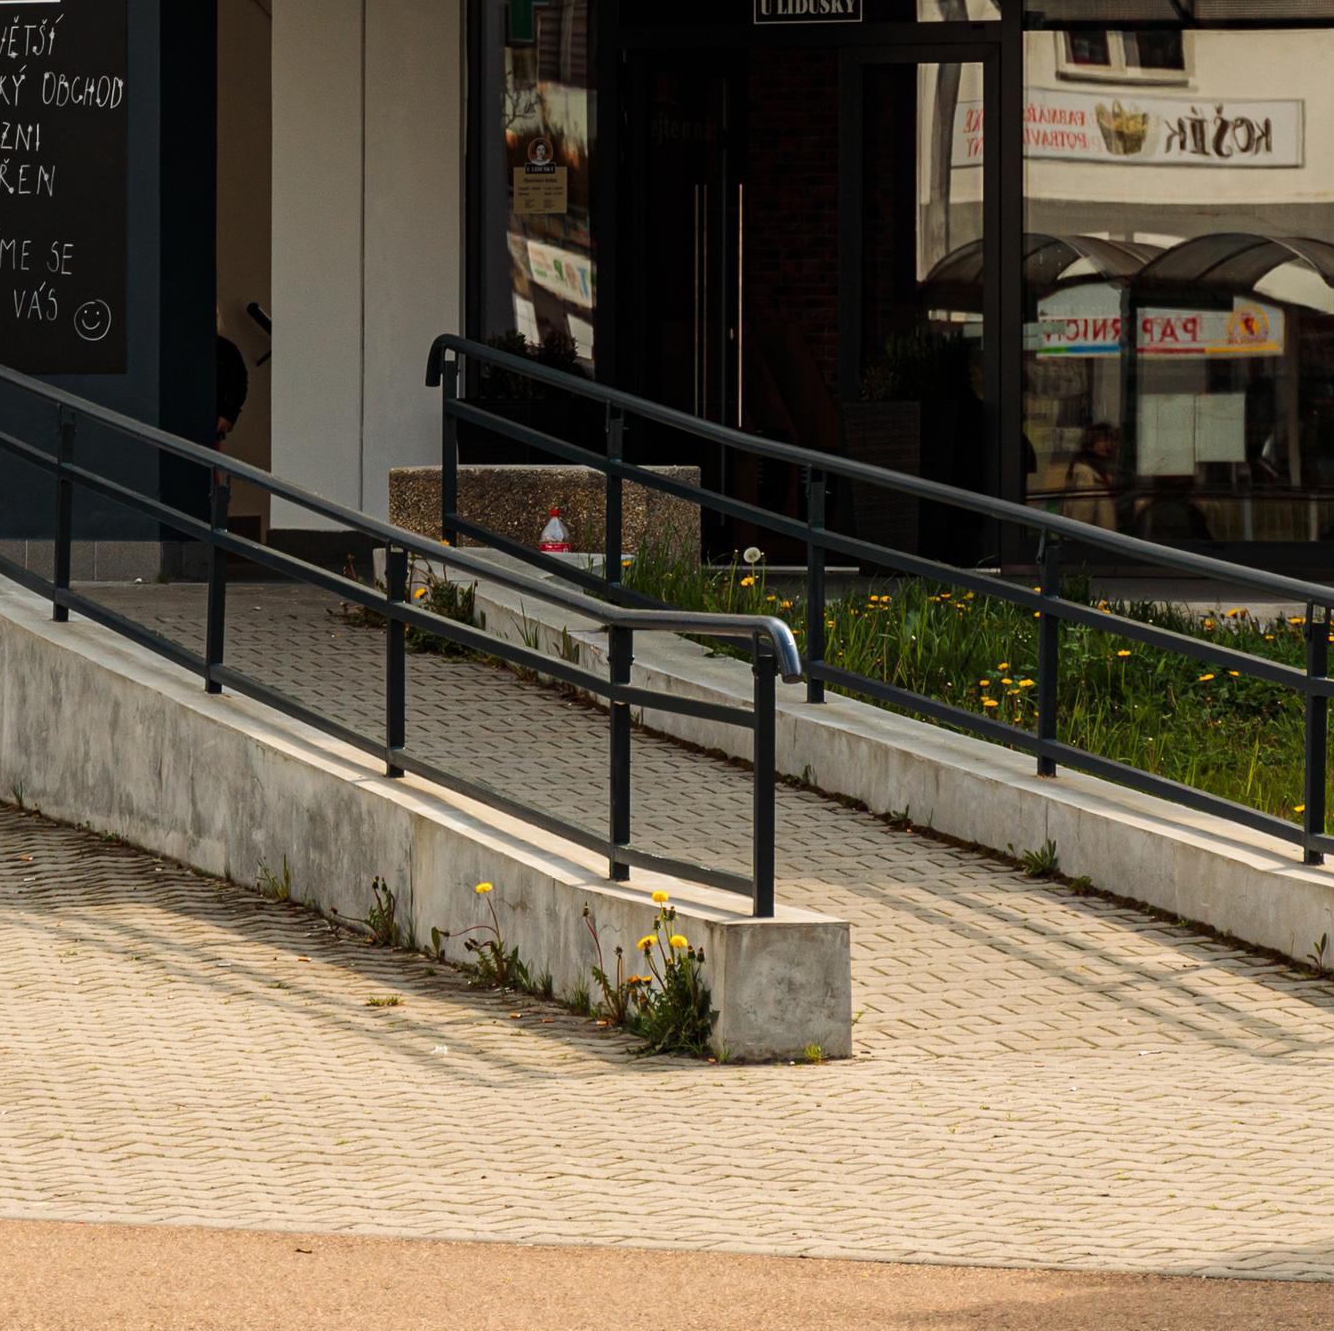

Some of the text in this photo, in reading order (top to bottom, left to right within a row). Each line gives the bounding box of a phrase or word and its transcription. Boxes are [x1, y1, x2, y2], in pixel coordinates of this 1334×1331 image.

[41, 71, 124, 109] OBCHOD
[46, 240, 75, 275] SE
[13, 281, 59, 321] VÁS
